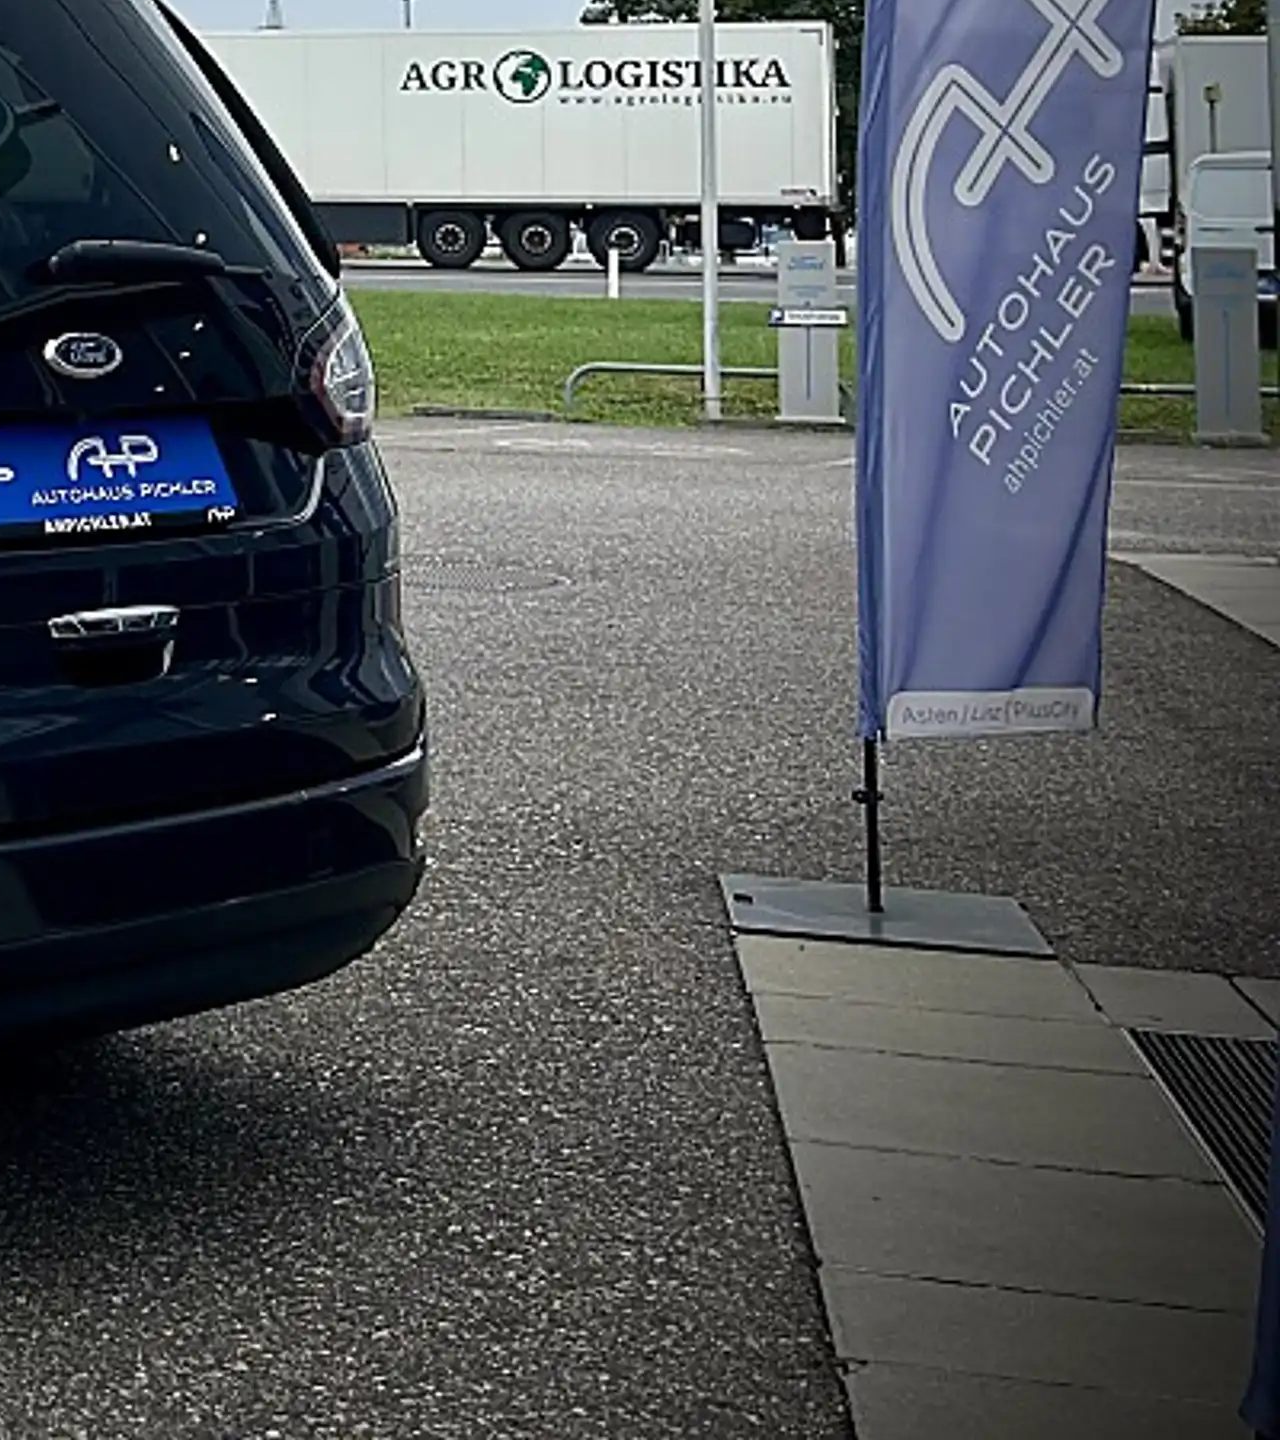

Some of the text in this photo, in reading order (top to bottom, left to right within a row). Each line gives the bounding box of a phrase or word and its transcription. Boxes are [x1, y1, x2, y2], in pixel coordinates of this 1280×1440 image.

[946, 153, 1117, 437] AUTOHAUS
[968, 242, 1116, 467] PICHLER
[31, 480, 217, 506] AUTOHAUS PICHLER
[1002, 349, 1100, 495] ahpichler.at
